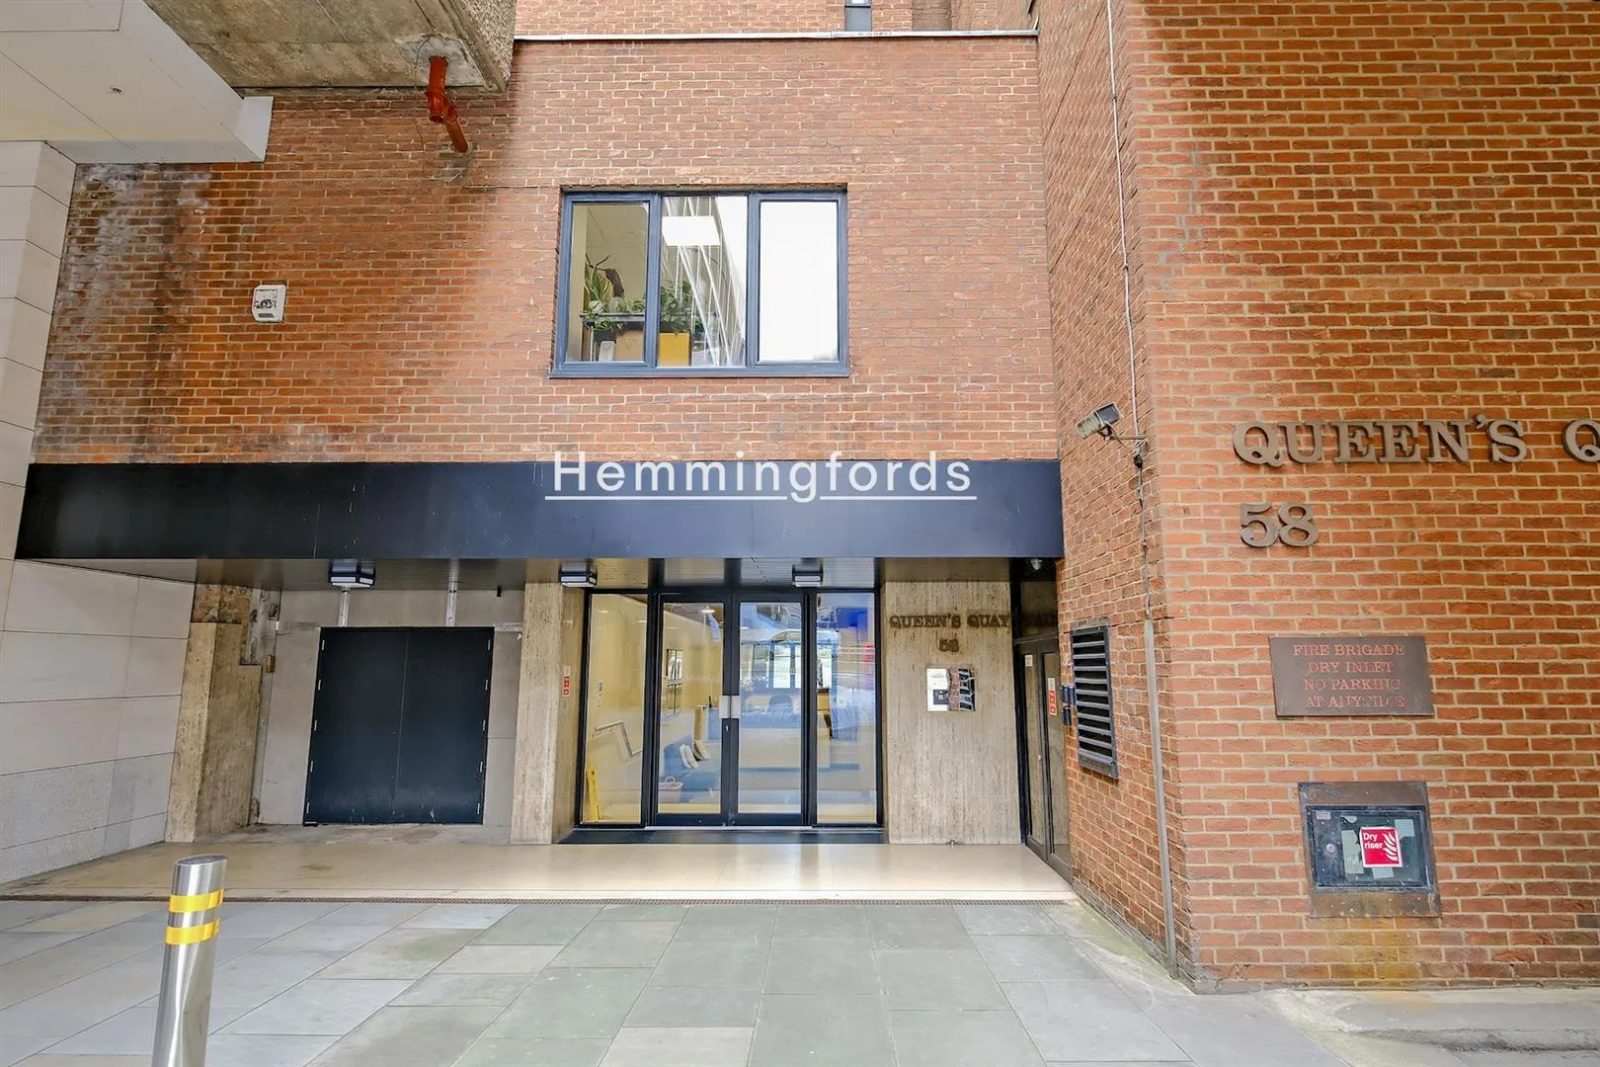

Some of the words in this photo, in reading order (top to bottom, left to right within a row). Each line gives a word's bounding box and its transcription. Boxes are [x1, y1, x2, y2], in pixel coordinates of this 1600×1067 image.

[1232, 414, 1528, 467] QUEEN'S
[1240, 502, 1319, 548] 58
[889, 614, 961, 628] QUEEN'S
[967, 614, 1009, 628] QUAY
[1293, 644, 1330, 656] FIRE
[1335, 644, 1405, 656] BRIGADE
[1307, 661, 1340, 673] DRY
[1346, 661, 1394, 673] INLET
[1303, 679, 1326, 692] NO
[1306, 696, 1323, 708] AT
[1363, 832, 1377, 842] Dry
